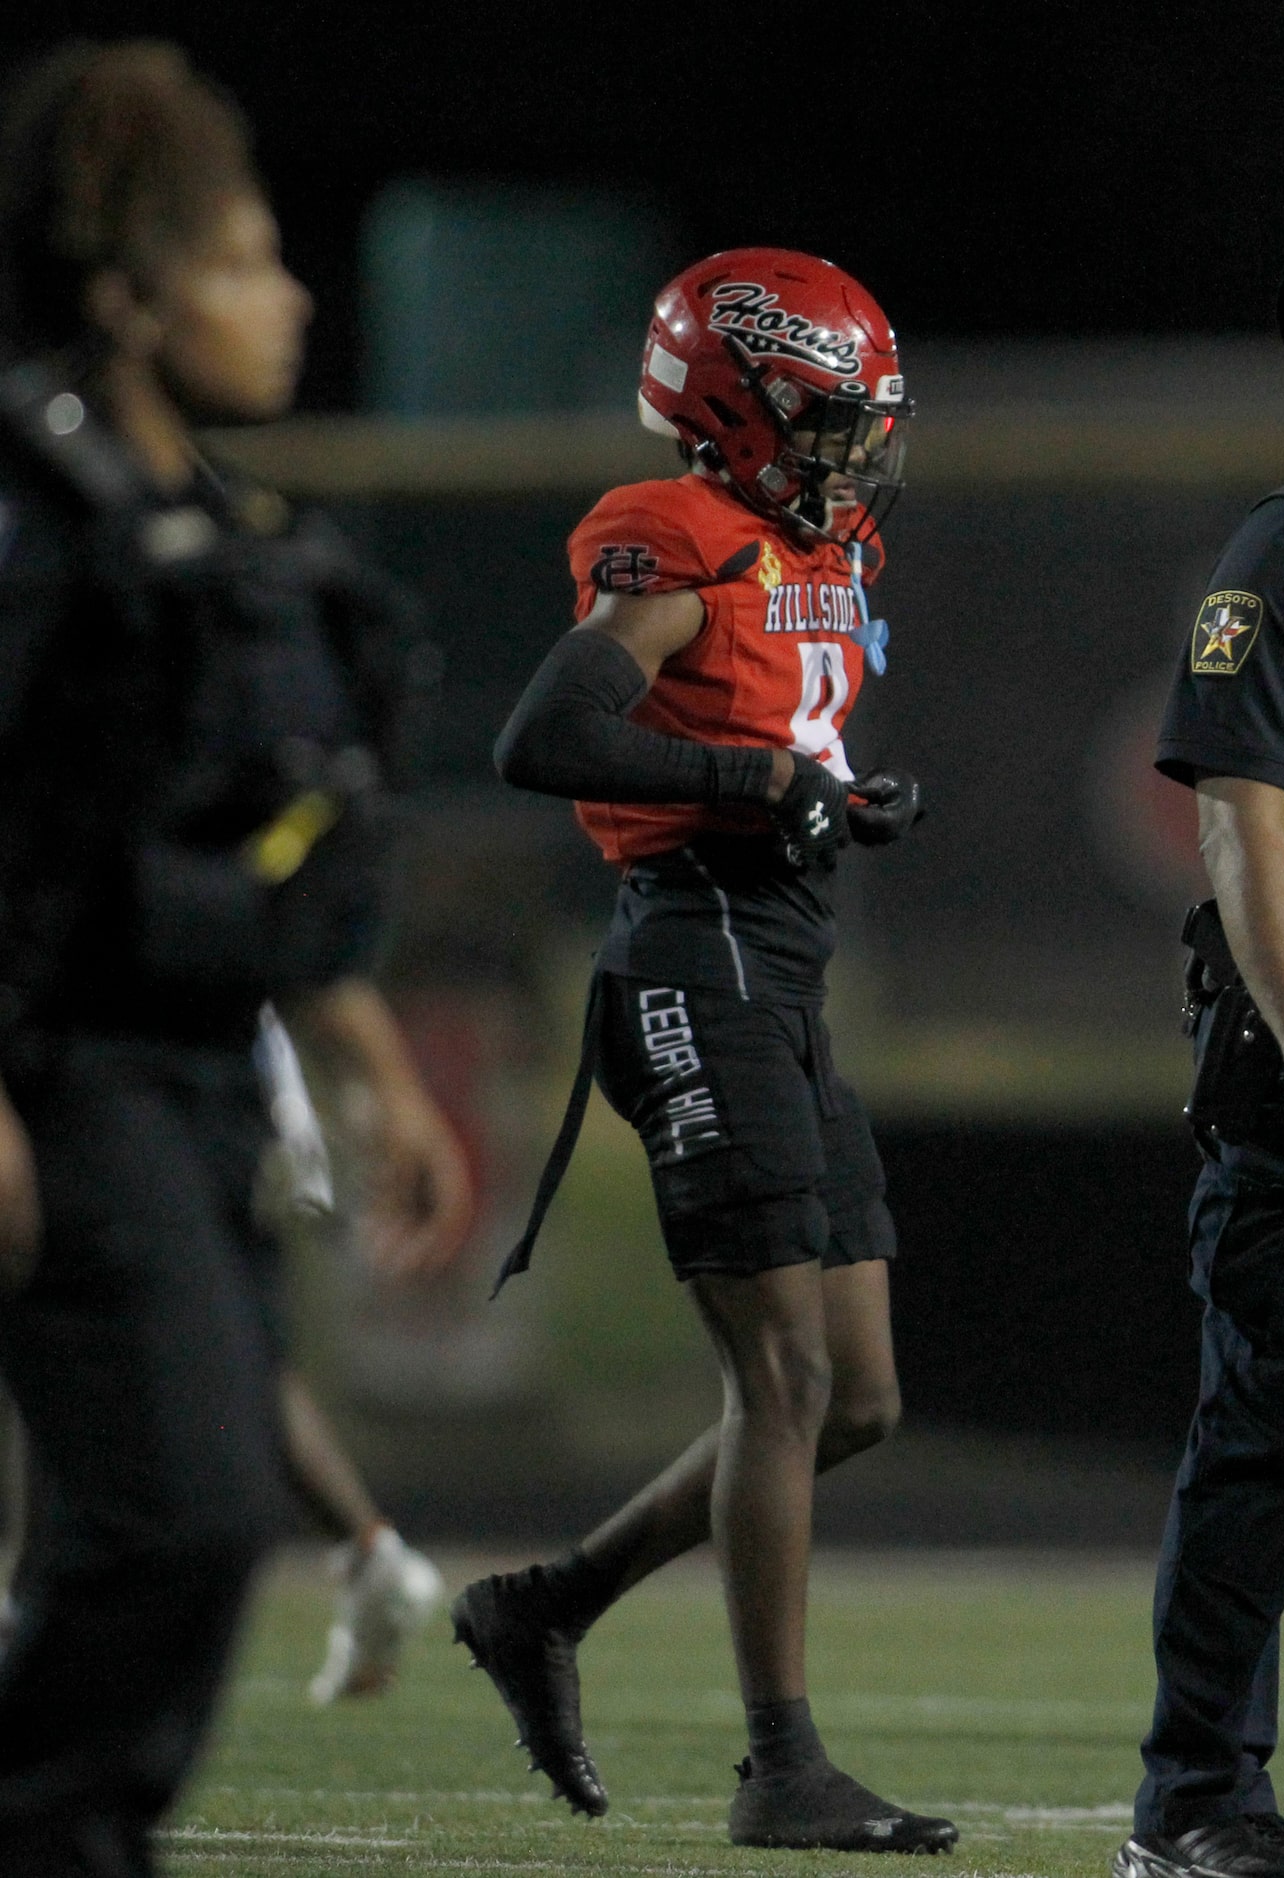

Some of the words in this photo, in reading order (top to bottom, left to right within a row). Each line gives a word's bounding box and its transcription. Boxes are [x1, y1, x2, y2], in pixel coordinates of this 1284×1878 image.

[710, 283, 862, 376] Horns
[1195, 661, 1235, 671] POLICE
[639, 987, 702, 1085] CEDAR
